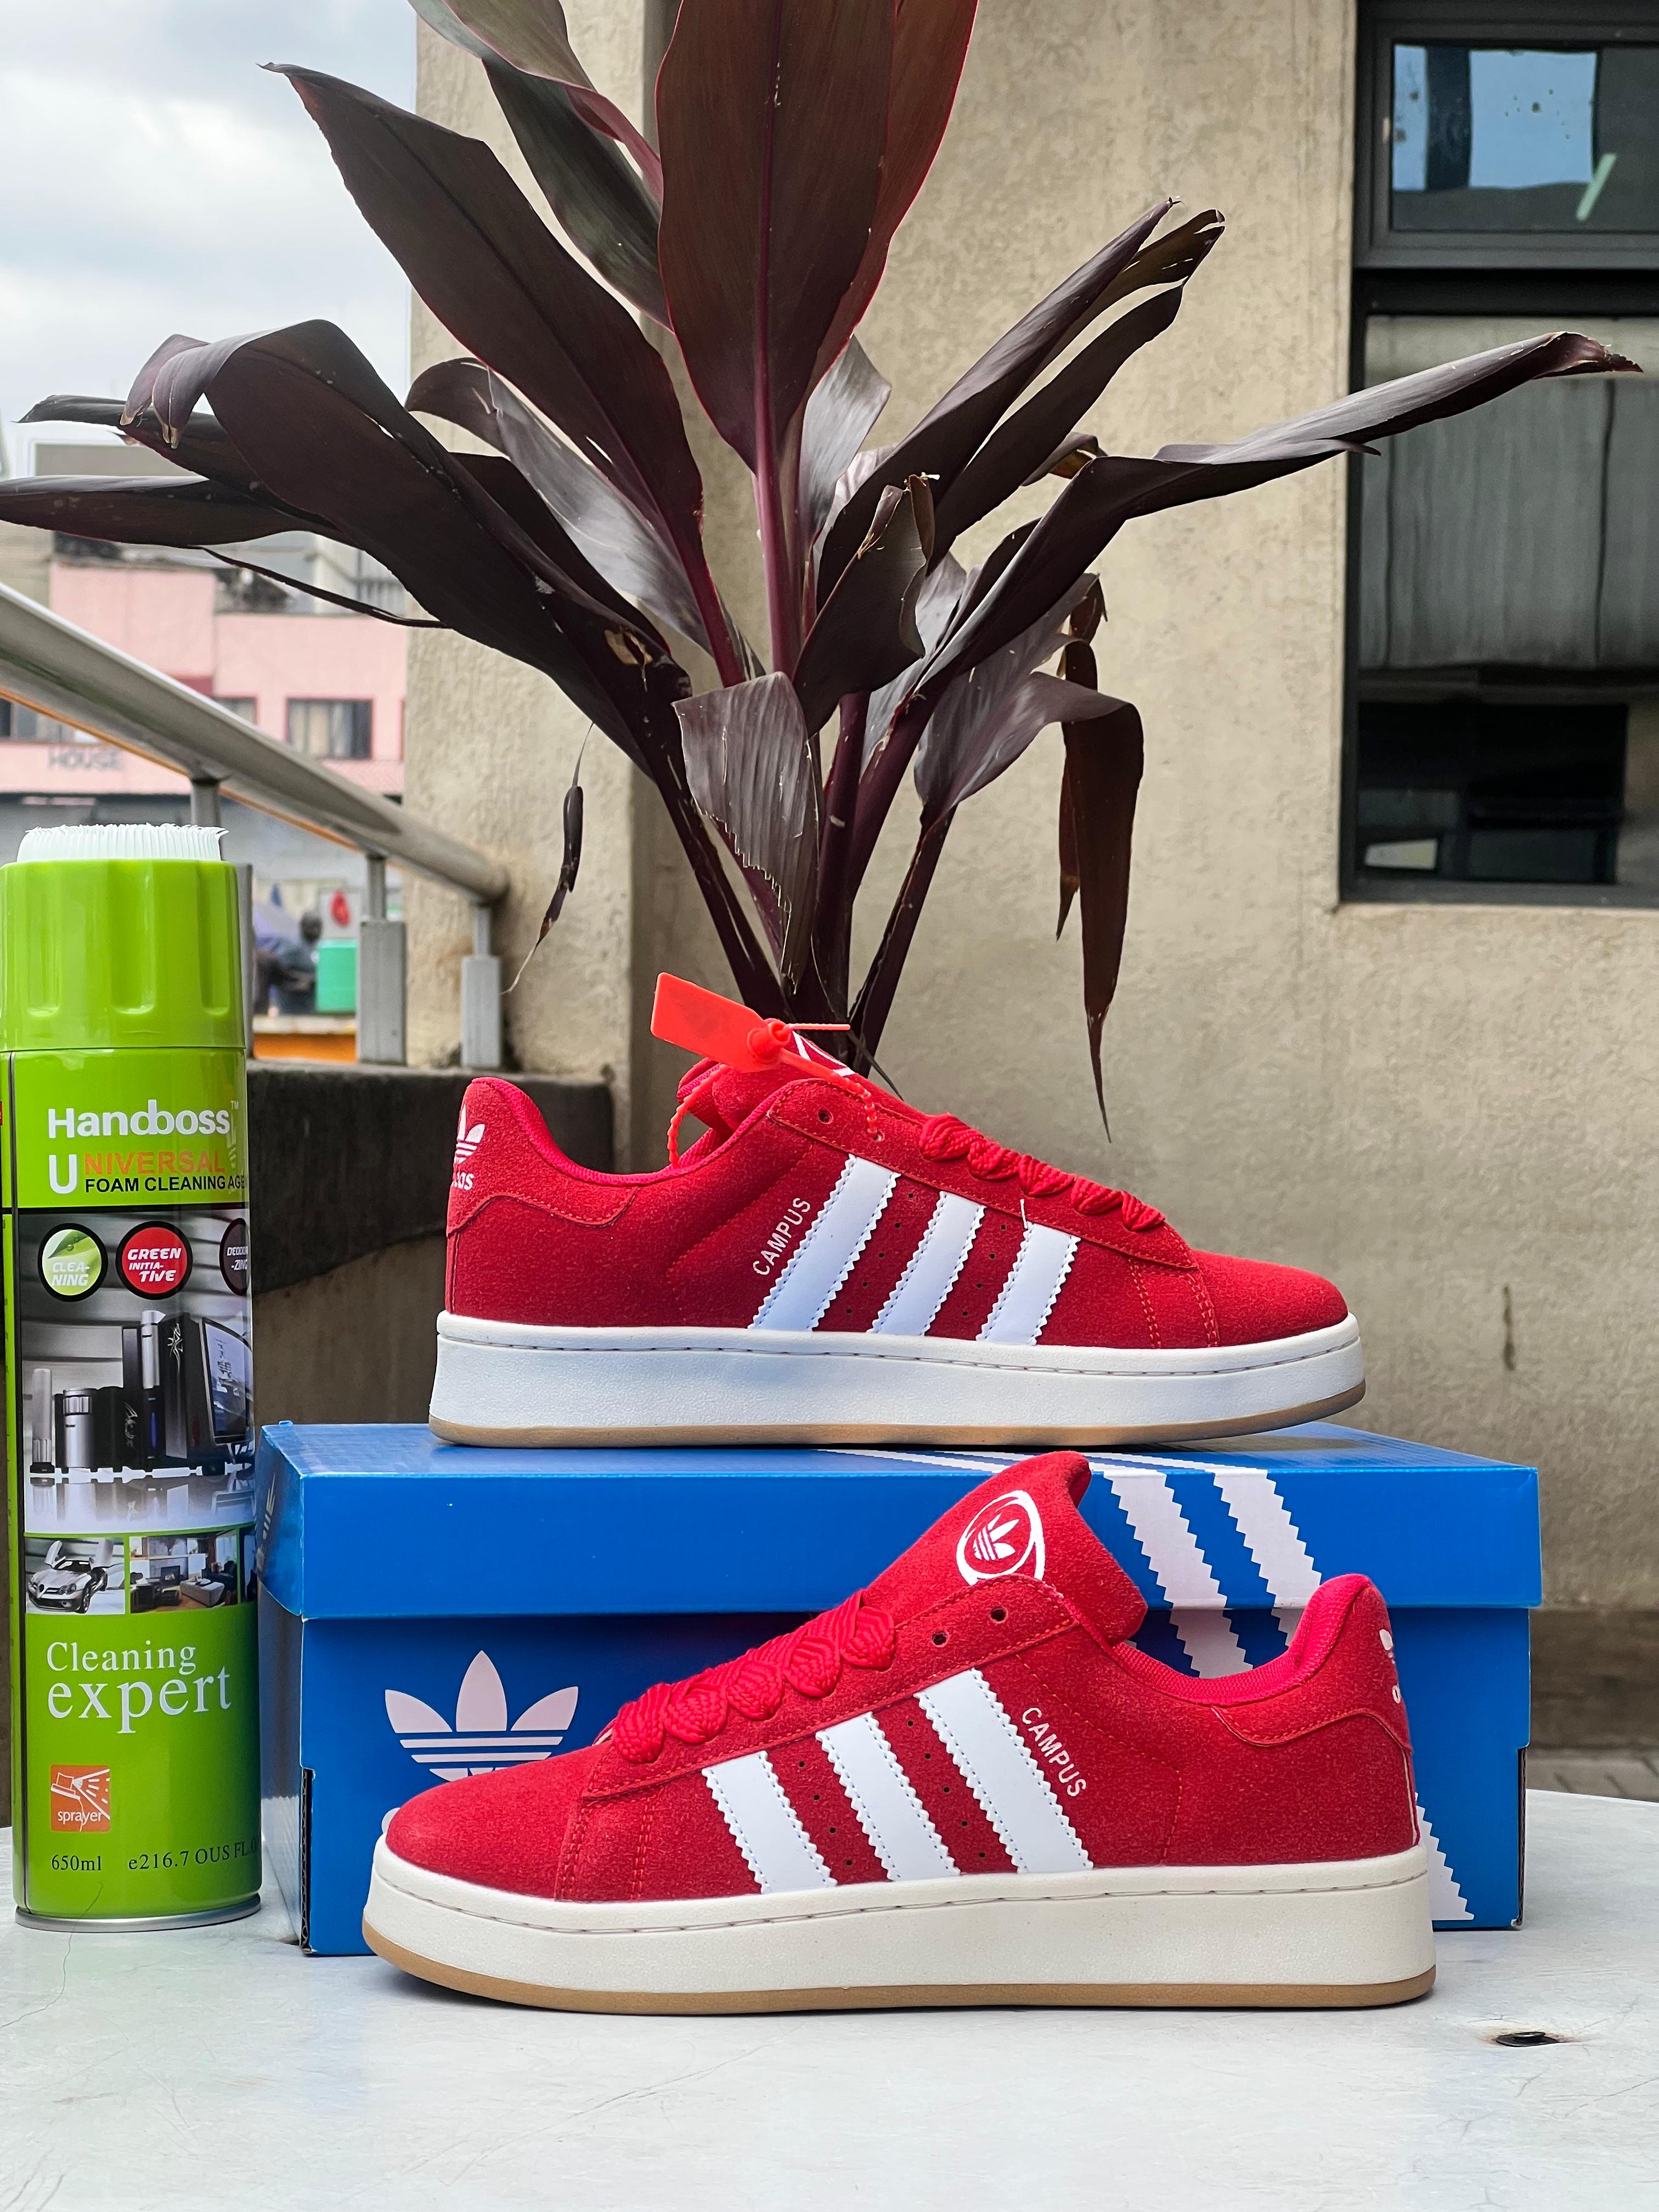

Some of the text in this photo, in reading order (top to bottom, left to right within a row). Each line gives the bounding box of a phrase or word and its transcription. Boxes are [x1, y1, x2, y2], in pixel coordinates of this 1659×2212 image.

[48, 1099, 230, 1138] Handboss
[86, 1177, 139, 1193] FOAM
[145, 1176, 225, 1192] CLEANING
[753, 1198, 810, 1275] CAMPUS
[127, 1248, 182, 1260] GREEN
[128, 1262, 164, 1271] INITIA-
[138, 1269, 176, 1282] TIVE
[52, 1274, 89, 1286] NING
[47, 1640, 196, 1675] Cleaning
[48, 1666, 232, 1734] expert
[1022, 1707, 1087, 1797] CAMPUS
[58, 1810, 103, 1826] sprayer
[52, 1854, 101, 1871] 650ml
[128, 1850, 189, 1870] e216.7
